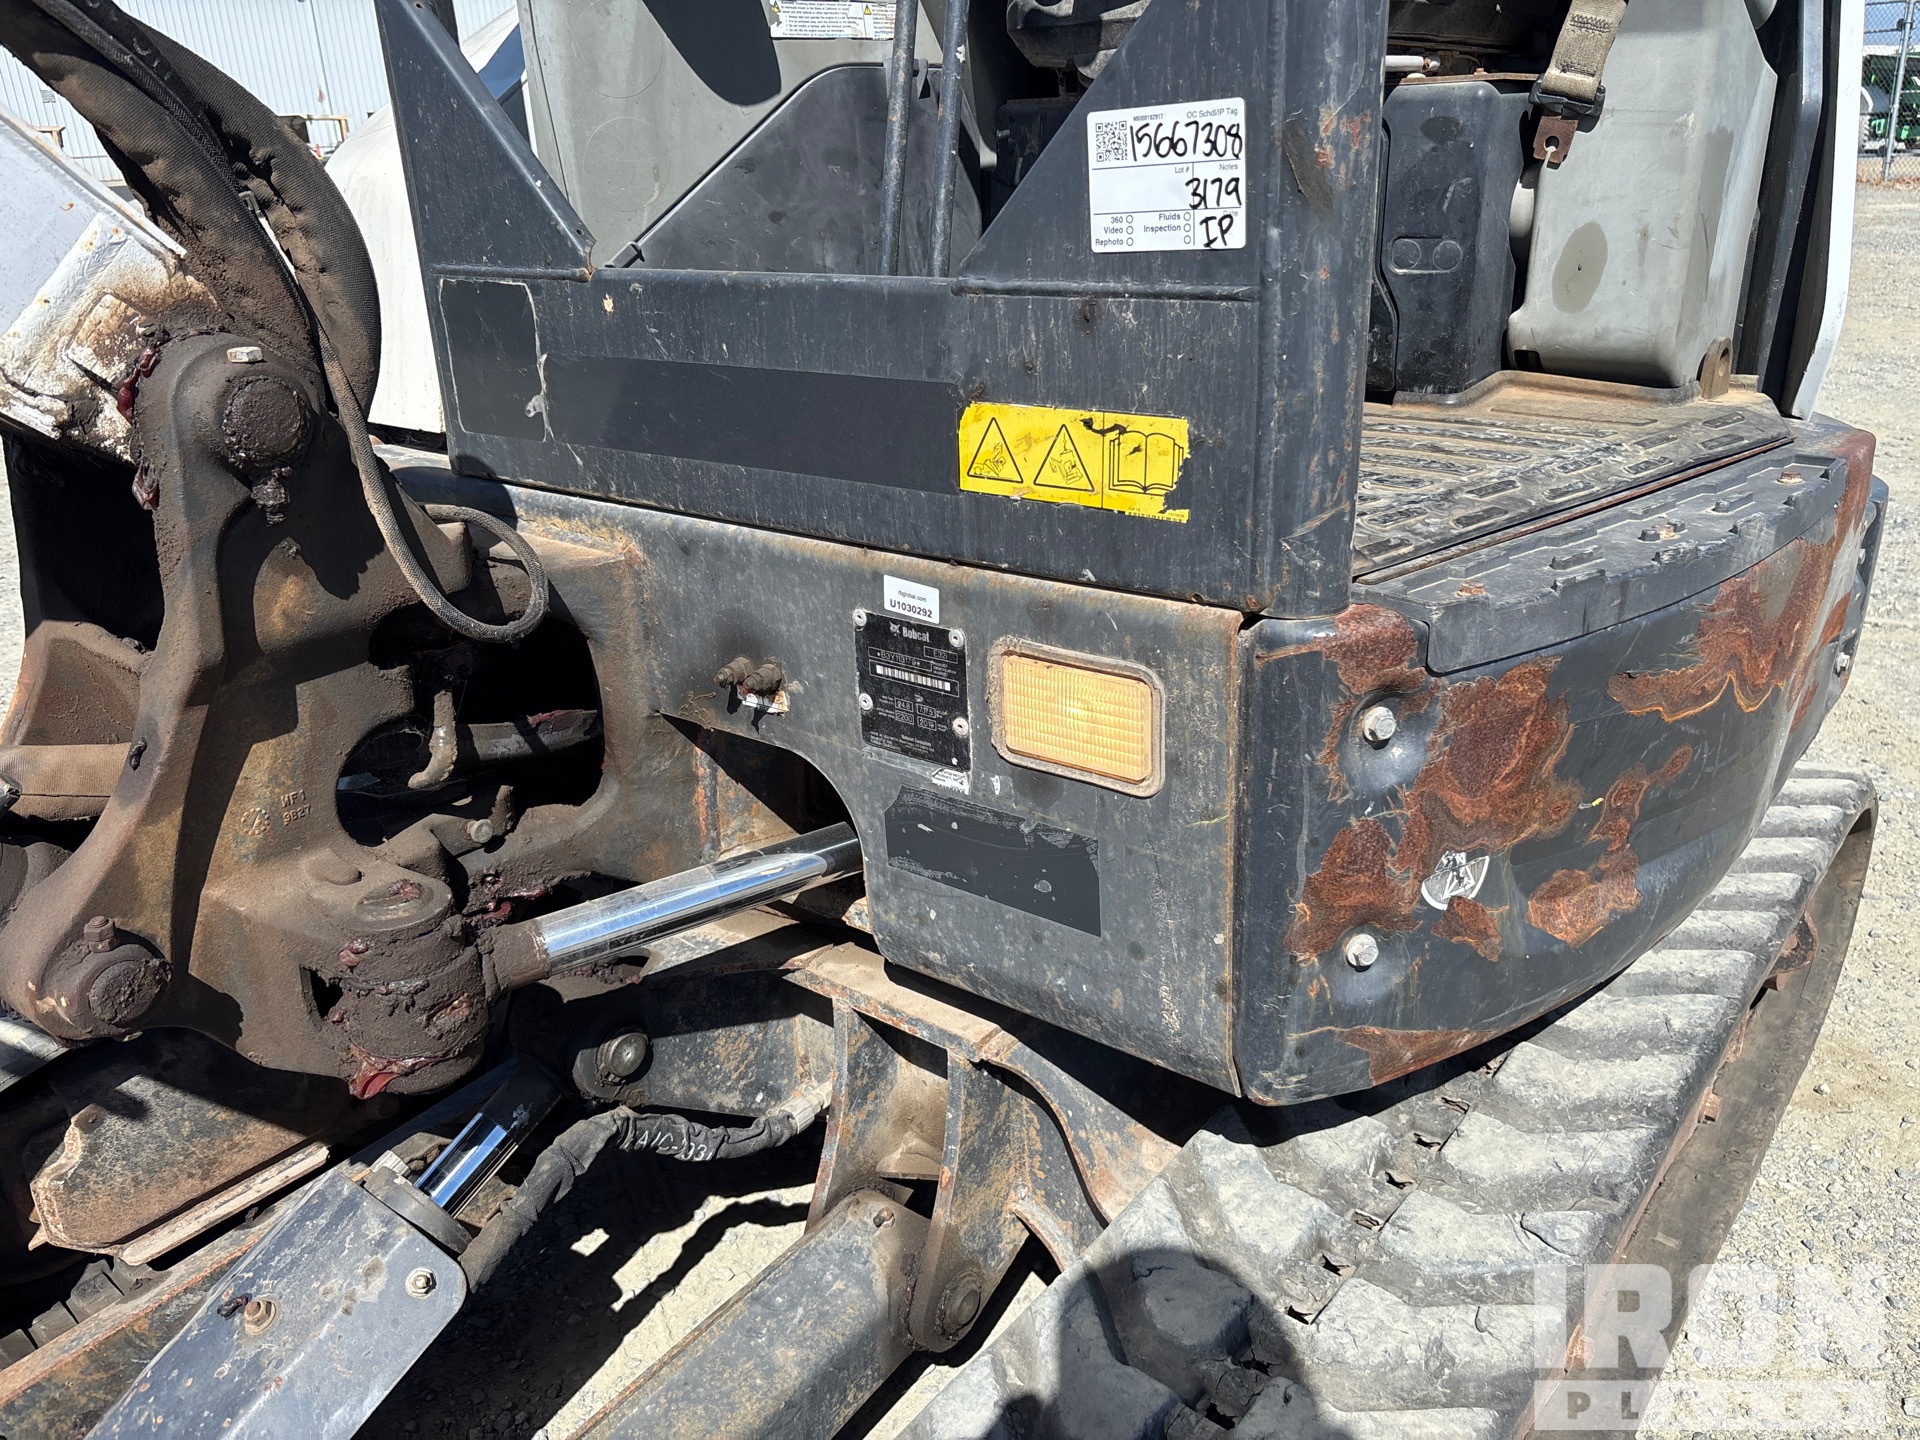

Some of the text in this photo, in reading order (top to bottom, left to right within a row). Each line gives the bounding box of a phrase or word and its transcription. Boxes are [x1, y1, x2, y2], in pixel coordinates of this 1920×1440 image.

[1186, 110, 1198, 119] OC
[1226, 107, 1239, 117] Tag
[1129, 120, 1243, 162] 15667308
[1219, 163, 1239, 171] Notes
[1185, 177, 1243, 210] 3179
[1110, 216, 1124, 224] 360
[1158, 213, 1181, 221] Fluids
[1103, 226, 1124, 234] Video
[1143, 224, 1182, 234] Inspection
[1199, 214, 1234, 249] IP
[1095, 238, 1124, 247] Rephoto
[889, 598, 933, 618] U1030292
[902, 626, 930, 643] Bobcat
